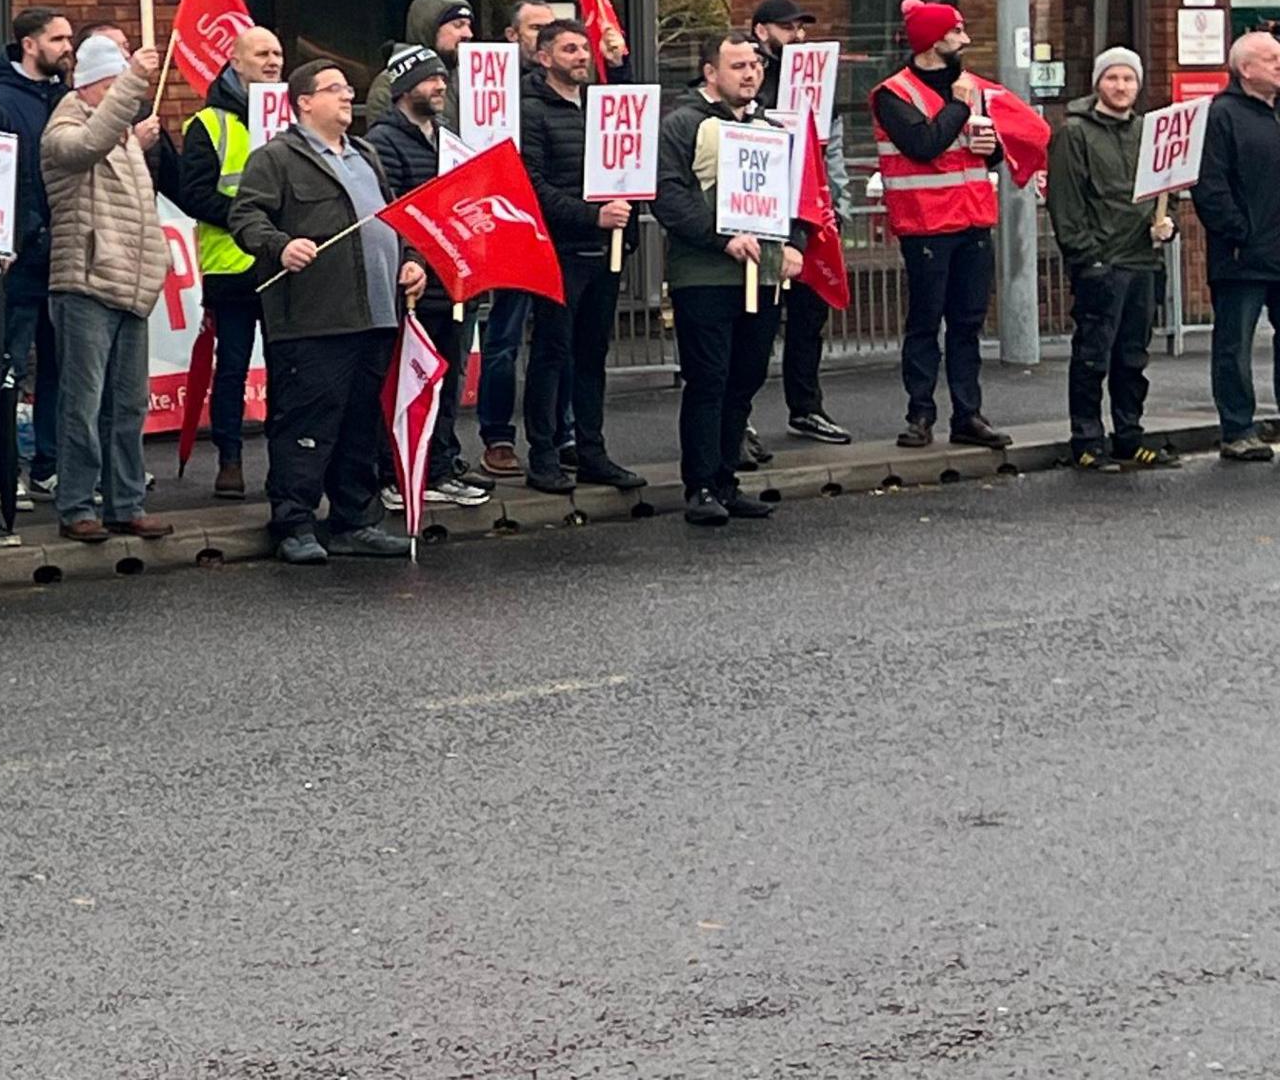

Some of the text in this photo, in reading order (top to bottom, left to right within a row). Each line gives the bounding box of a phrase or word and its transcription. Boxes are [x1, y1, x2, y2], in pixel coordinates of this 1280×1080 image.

[470, 51, 509, 88] PAY
[790, 50, 829, 85] PAY
[262, 91, 292, 128] PA
[473, 90, 507, 127] UP!
[600, 94, 648, 131] PAY
[1153, 105, 1198, 145] PAY
[602, 133, 642, 170] UP!
[739, 148, 770, 171] PAY
[1152, 137, 1190, 174] UP!
[742, 172, 766, 193] UP
[730, 193, 778, 219] NOW!
